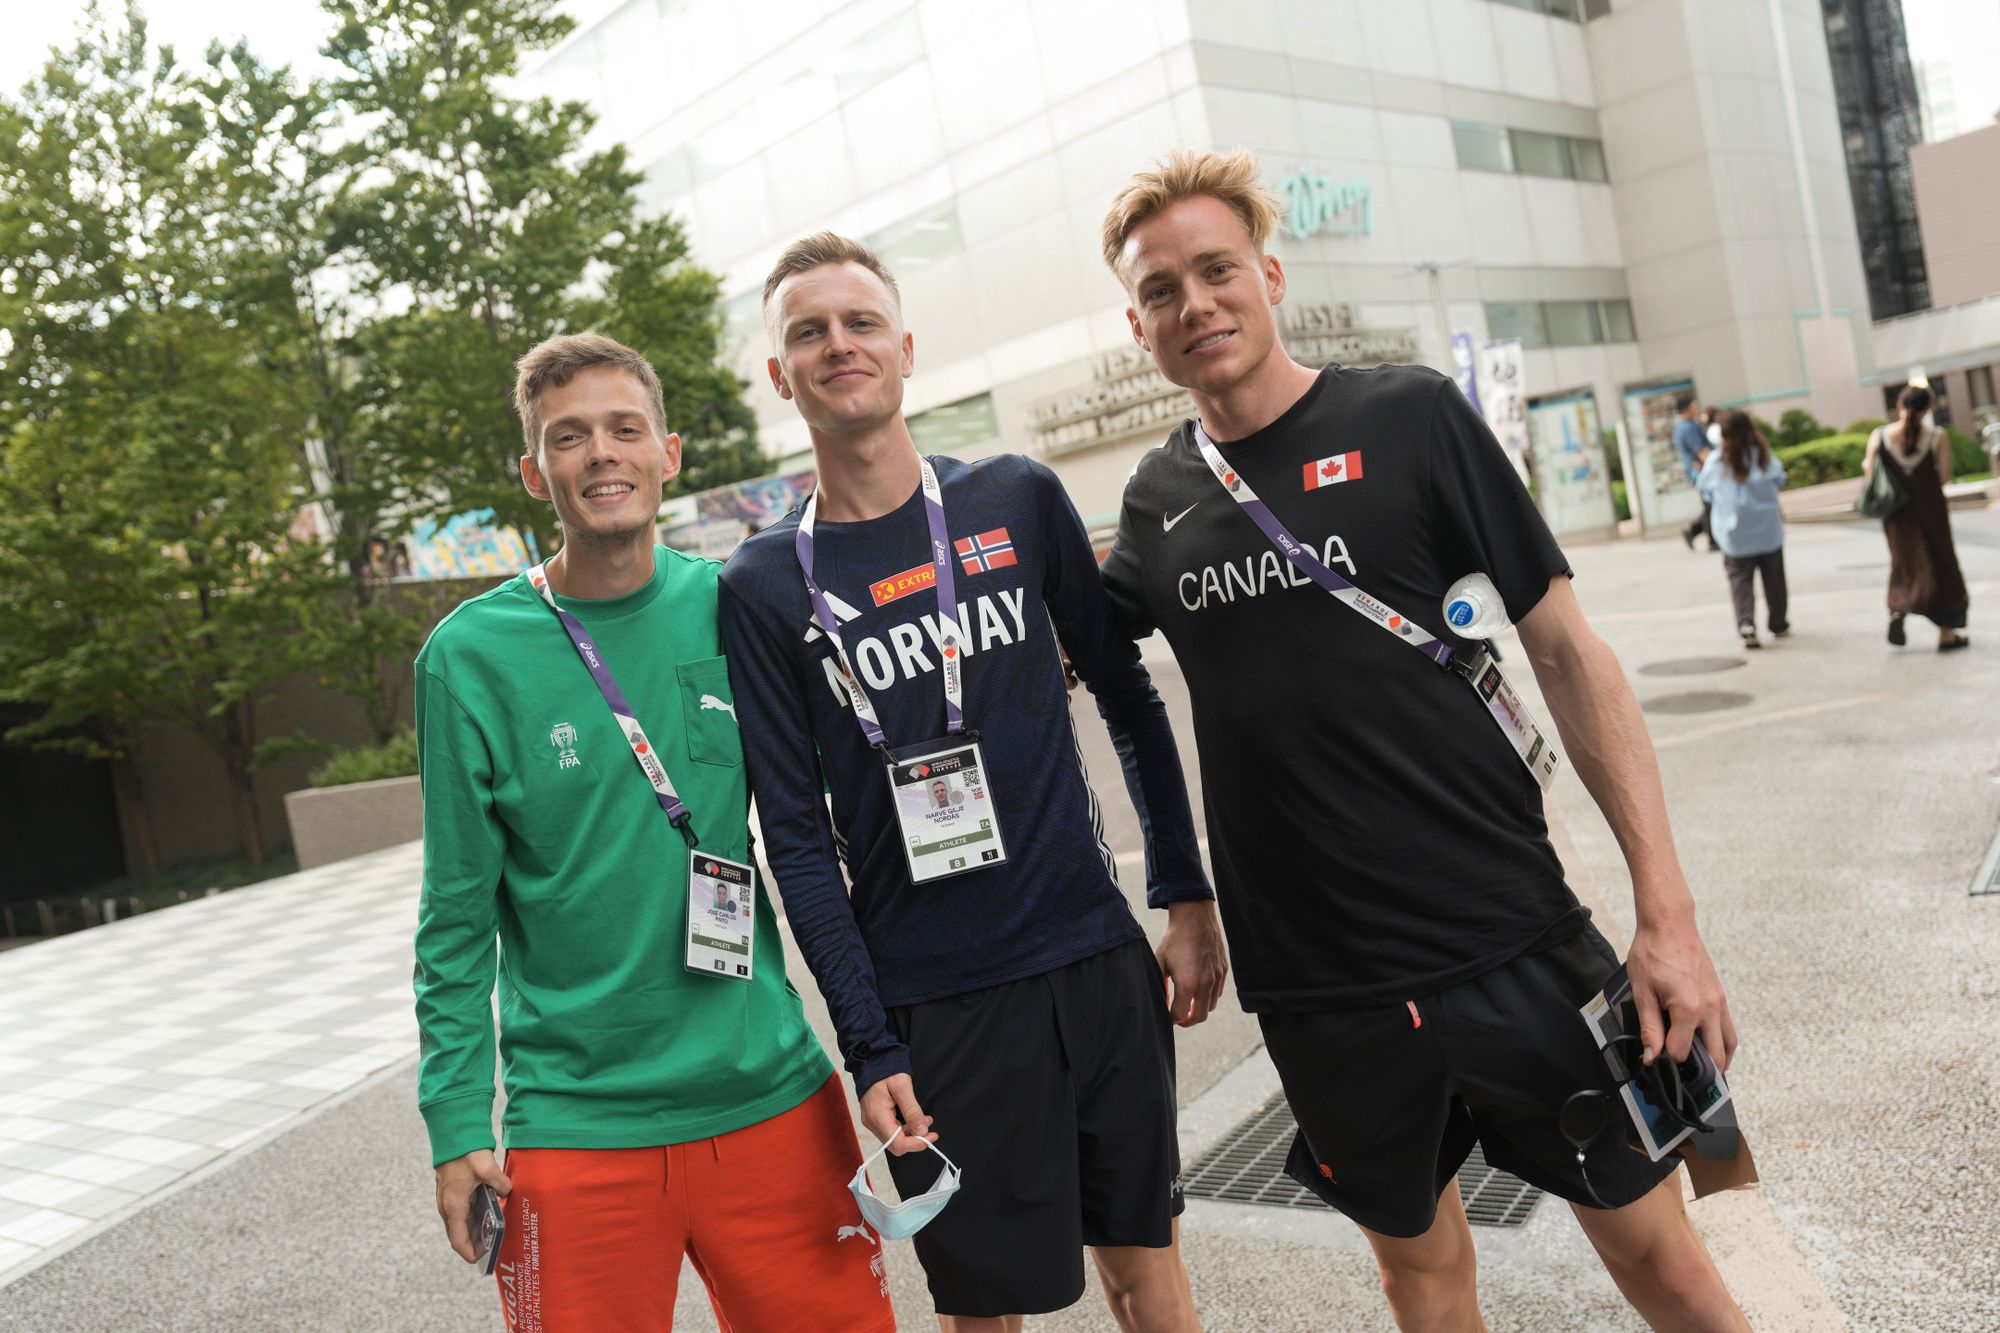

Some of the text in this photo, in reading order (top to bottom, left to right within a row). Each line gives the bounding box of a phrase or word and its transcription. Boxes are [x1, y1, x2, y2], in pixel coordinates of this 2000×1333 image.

[1178, 535, 1357, 611] CANADA
[585, 651, 600, 668] asics
[821, 587, 1027, 708] NORWAY
[559, 756, 581, 770] FPA
[925, 809, 947, 820] NARVE
[938, 837, 967, 849] ATHLETE
[710, 940, 731, 950] ATHLETE
[522, 1197, 530, 1231] LEGACY
[523, 1233, 531, 1251] THE
[524, 1253, 532, 1302] HONORING
[516, 1262, 526, 1329] PERFORMANCE
[532, 1274, 541, 1319] ATHLETES
